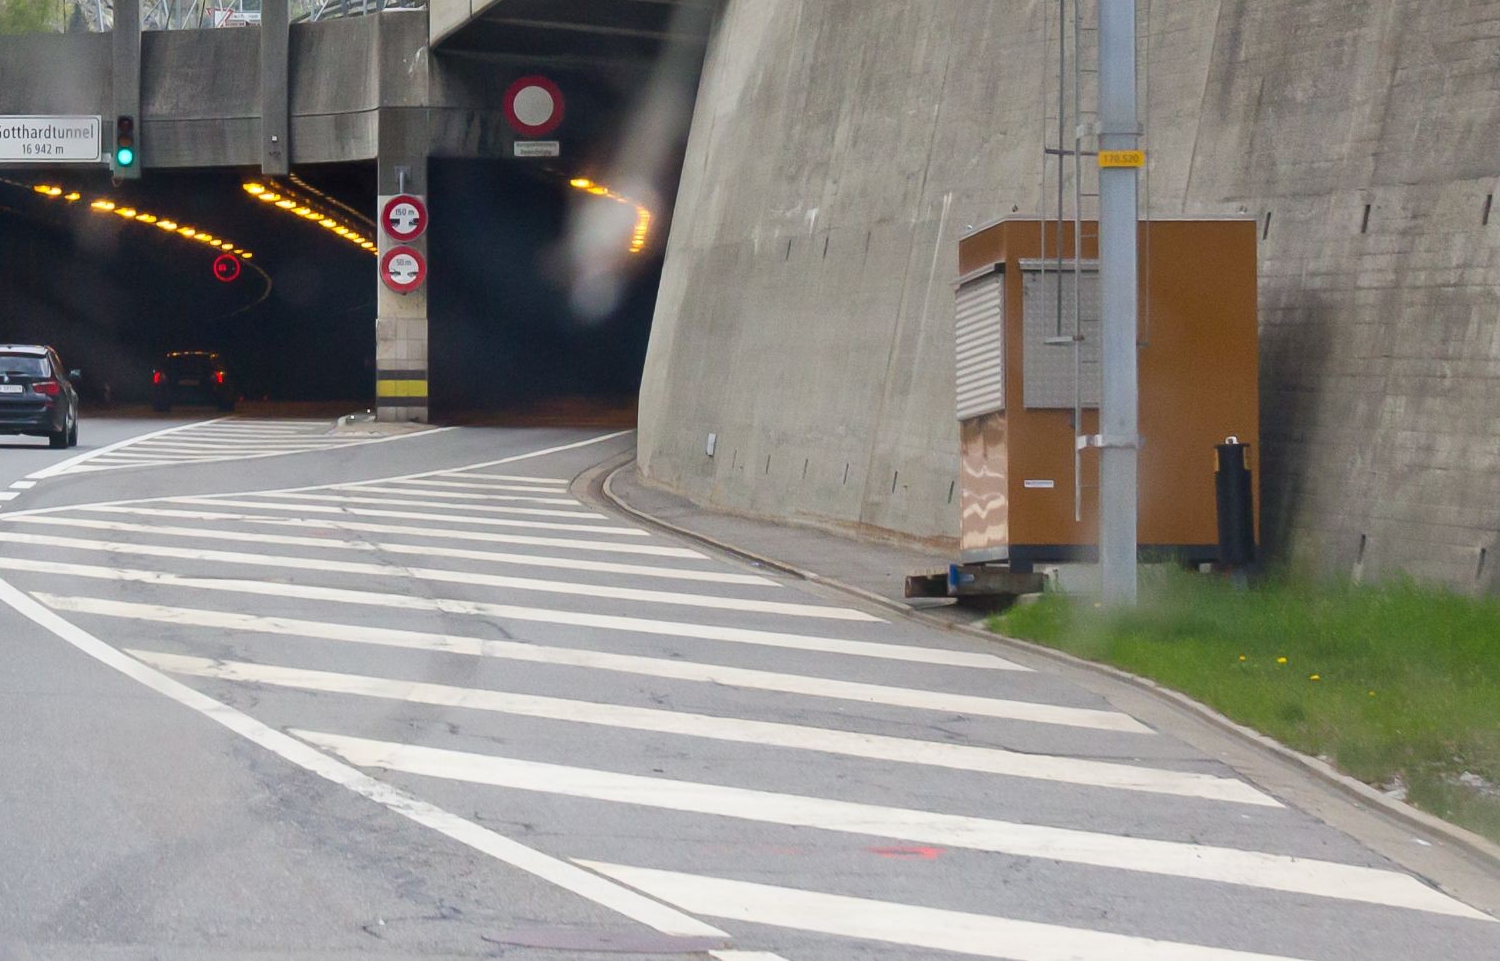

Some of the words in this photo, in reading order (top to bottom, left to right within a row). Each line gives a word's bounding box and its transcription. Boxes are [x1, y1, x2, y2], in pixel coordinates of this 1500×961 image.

[22, 143, 32, 154] 16
[35, 143, 52, 154] 942
[55, 146, 64, 154] m
[395, 208, 406, 216] 150
